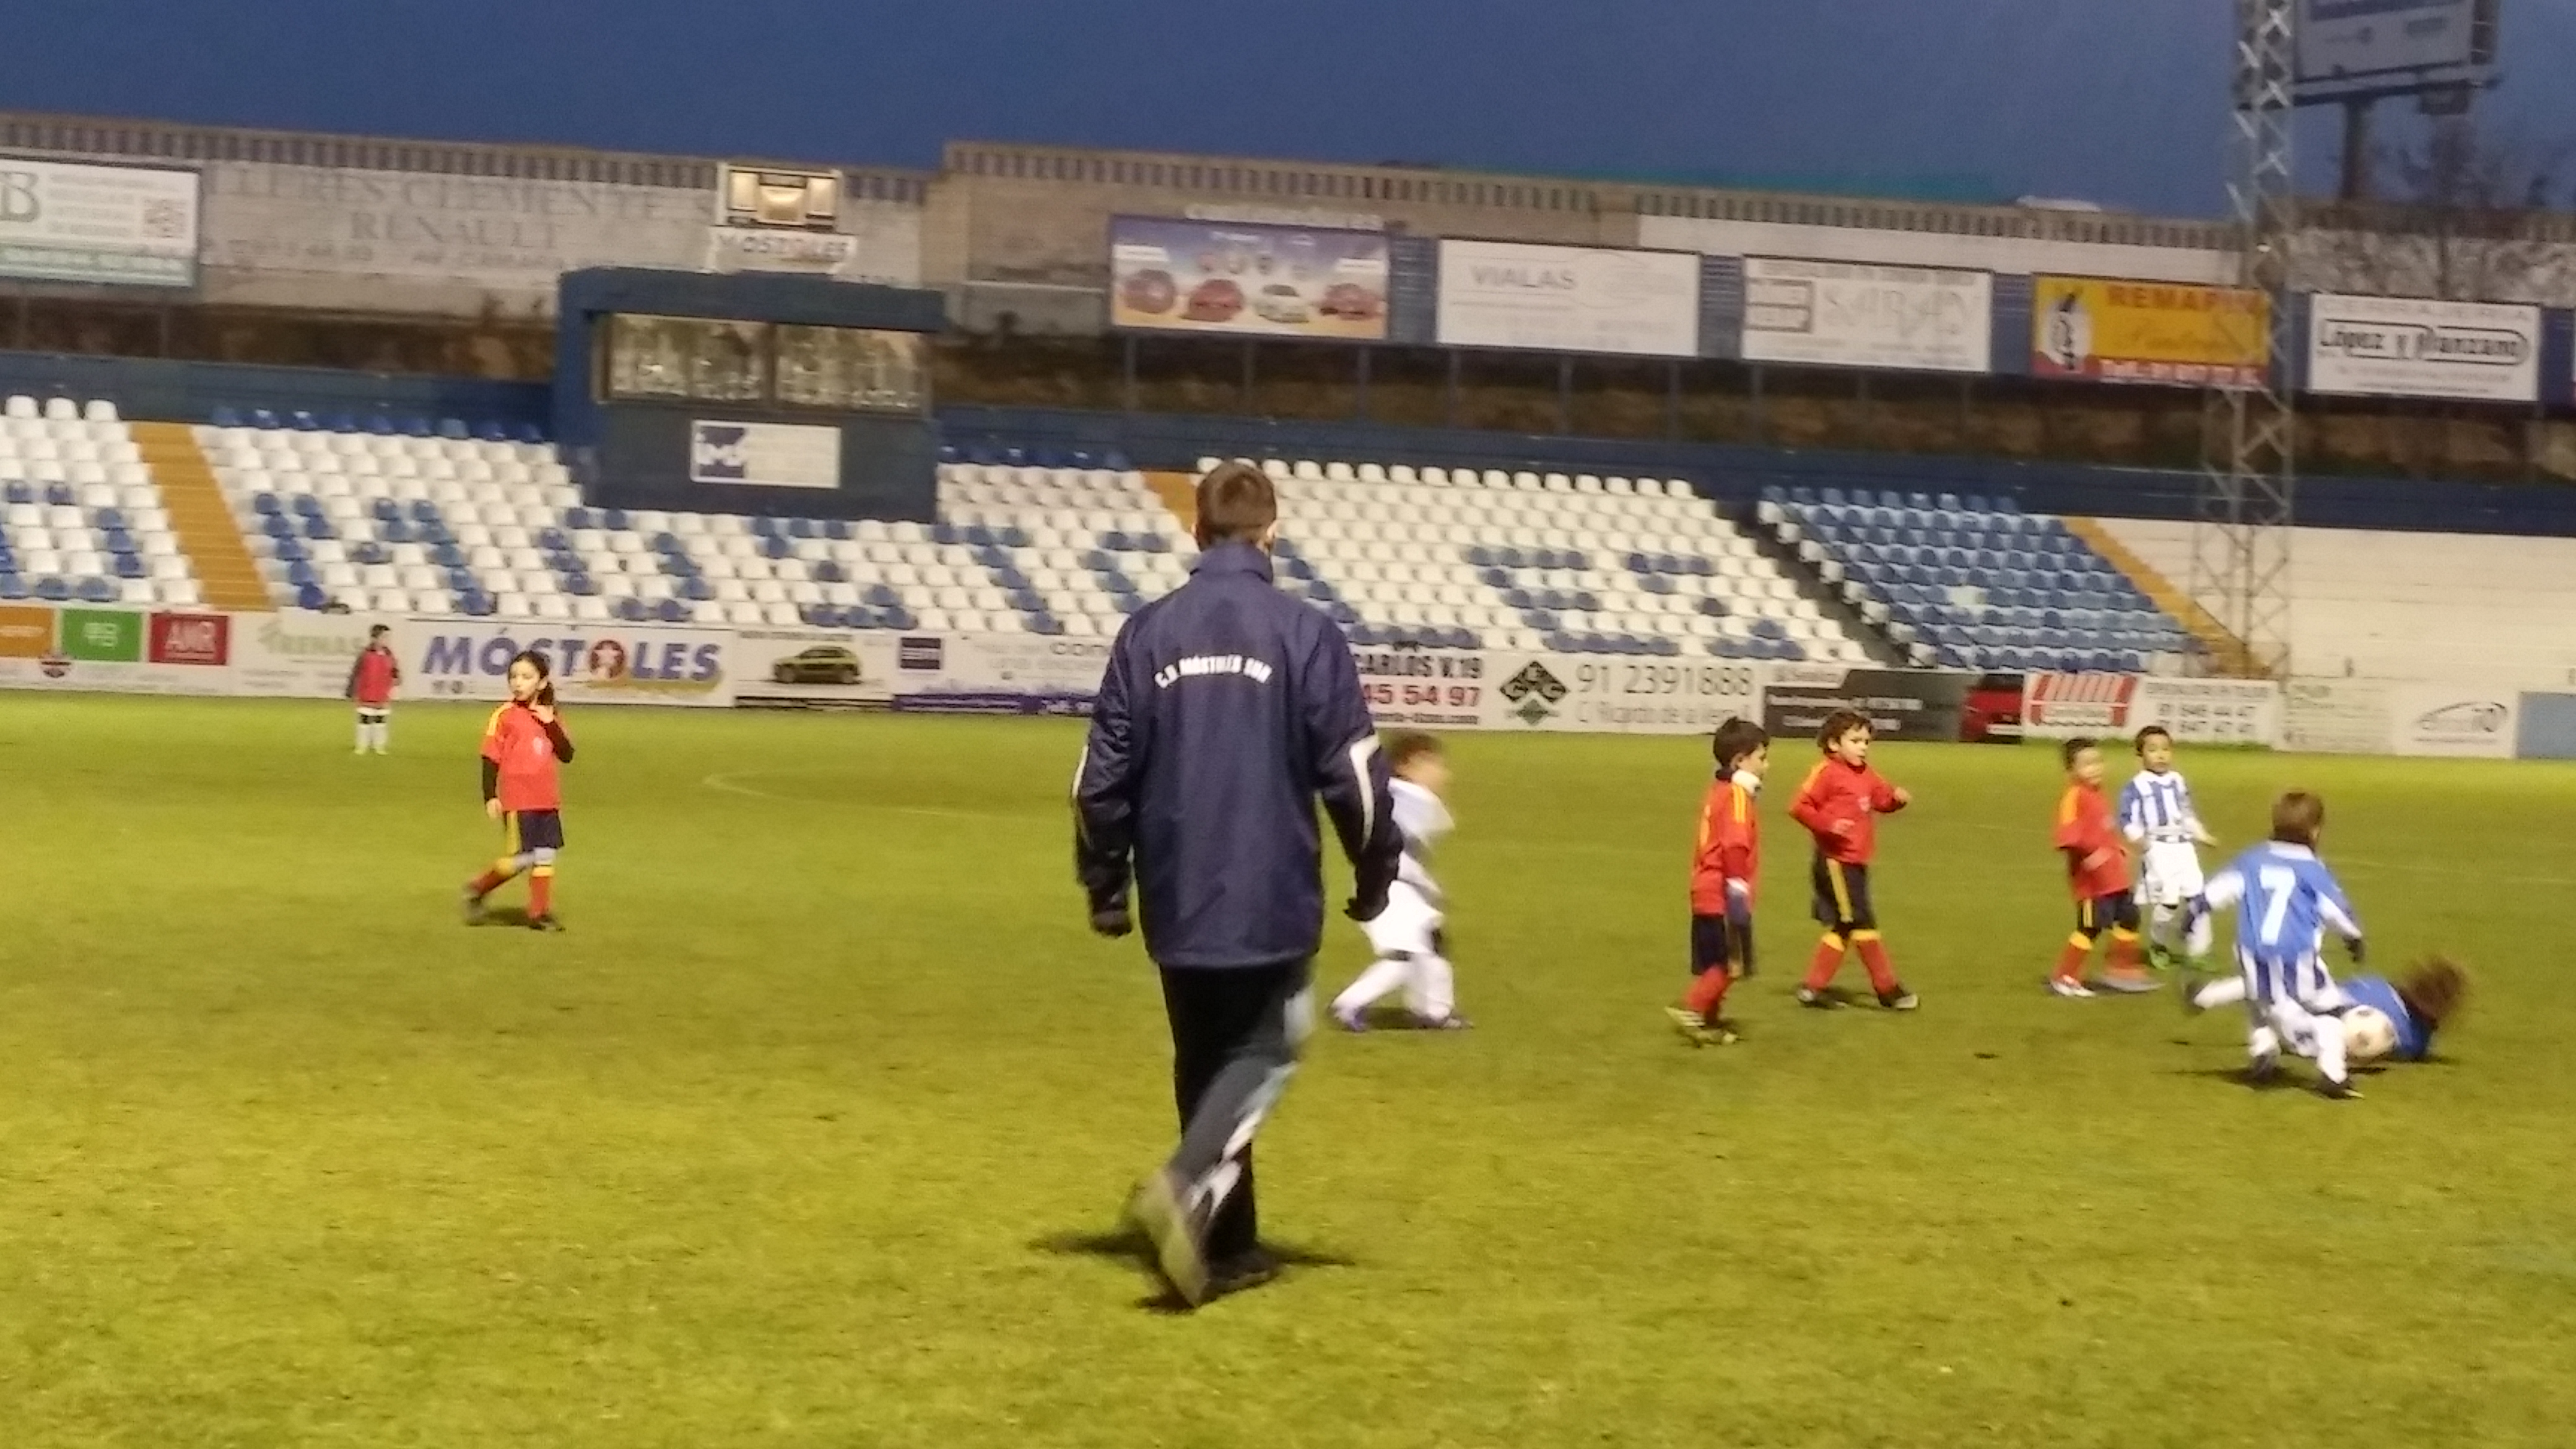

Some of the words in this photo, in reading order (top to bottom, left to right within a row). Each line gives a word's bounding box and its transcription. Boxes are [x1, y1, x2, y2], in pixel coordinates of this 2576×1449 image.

[422, 627, 721, 681] MÓSTOLES
[1403, 685, 1440, 706] 54
[1449, 686, 1480, 707] 97
[1576, 663, 1610, 694] 91
[1623, 665, 1754, 695] 2391888
[2259, 864, 2296, 946] 7
